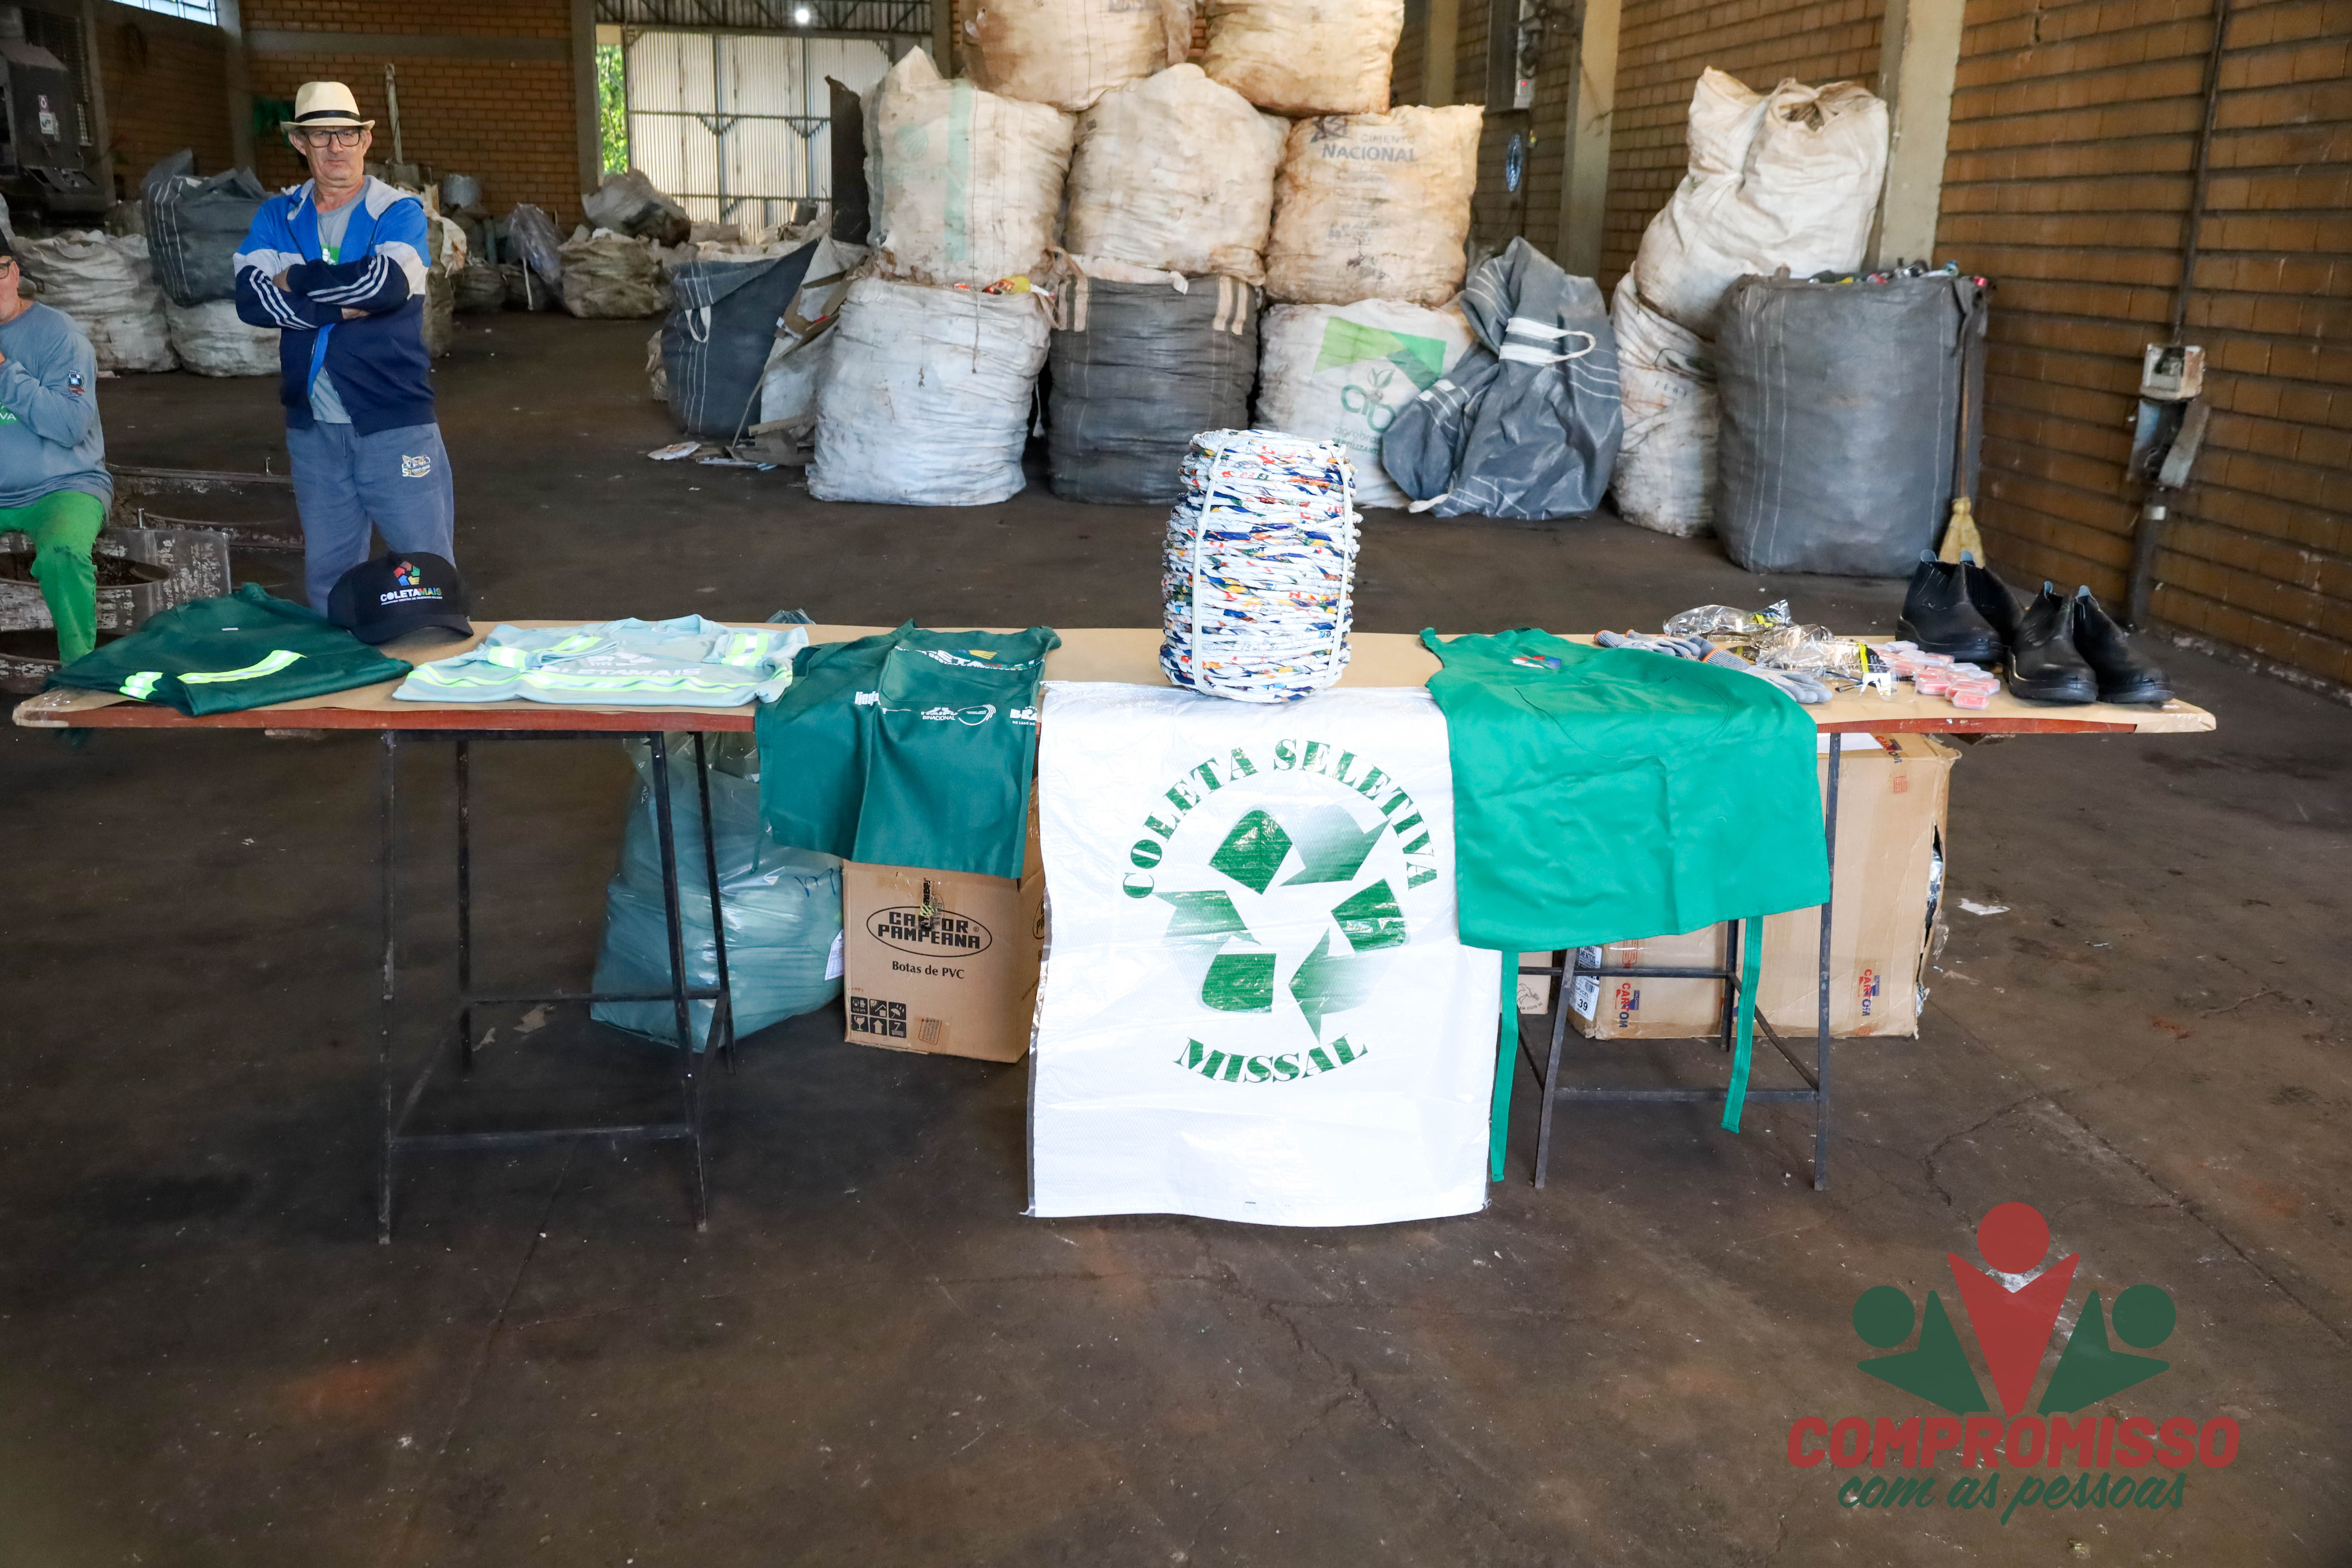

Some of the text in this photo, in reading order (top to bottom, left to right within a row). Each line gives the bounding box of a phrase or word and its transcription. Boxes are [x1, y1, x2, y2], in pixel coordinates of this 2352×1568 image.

[1322, 142, 1418, 162] NACIONAL
[380, 587, 443, 602] COLETAMAIS
[1122, 738, 1437, 899] COLETA SELETIVA
[889, 911, 968, 934] CAOR
[878, 924, 980, 949] PAMPEANA
[892, 960, 965, 979] Botas de PVC
[1862, 969, 1873, 1016] CARTOM
[1578, 999, 1588, 1011] 39
[1619, 983, 1631, 1028] CARTOM
[1173, 1034, 1368, 1083] MISSAL
